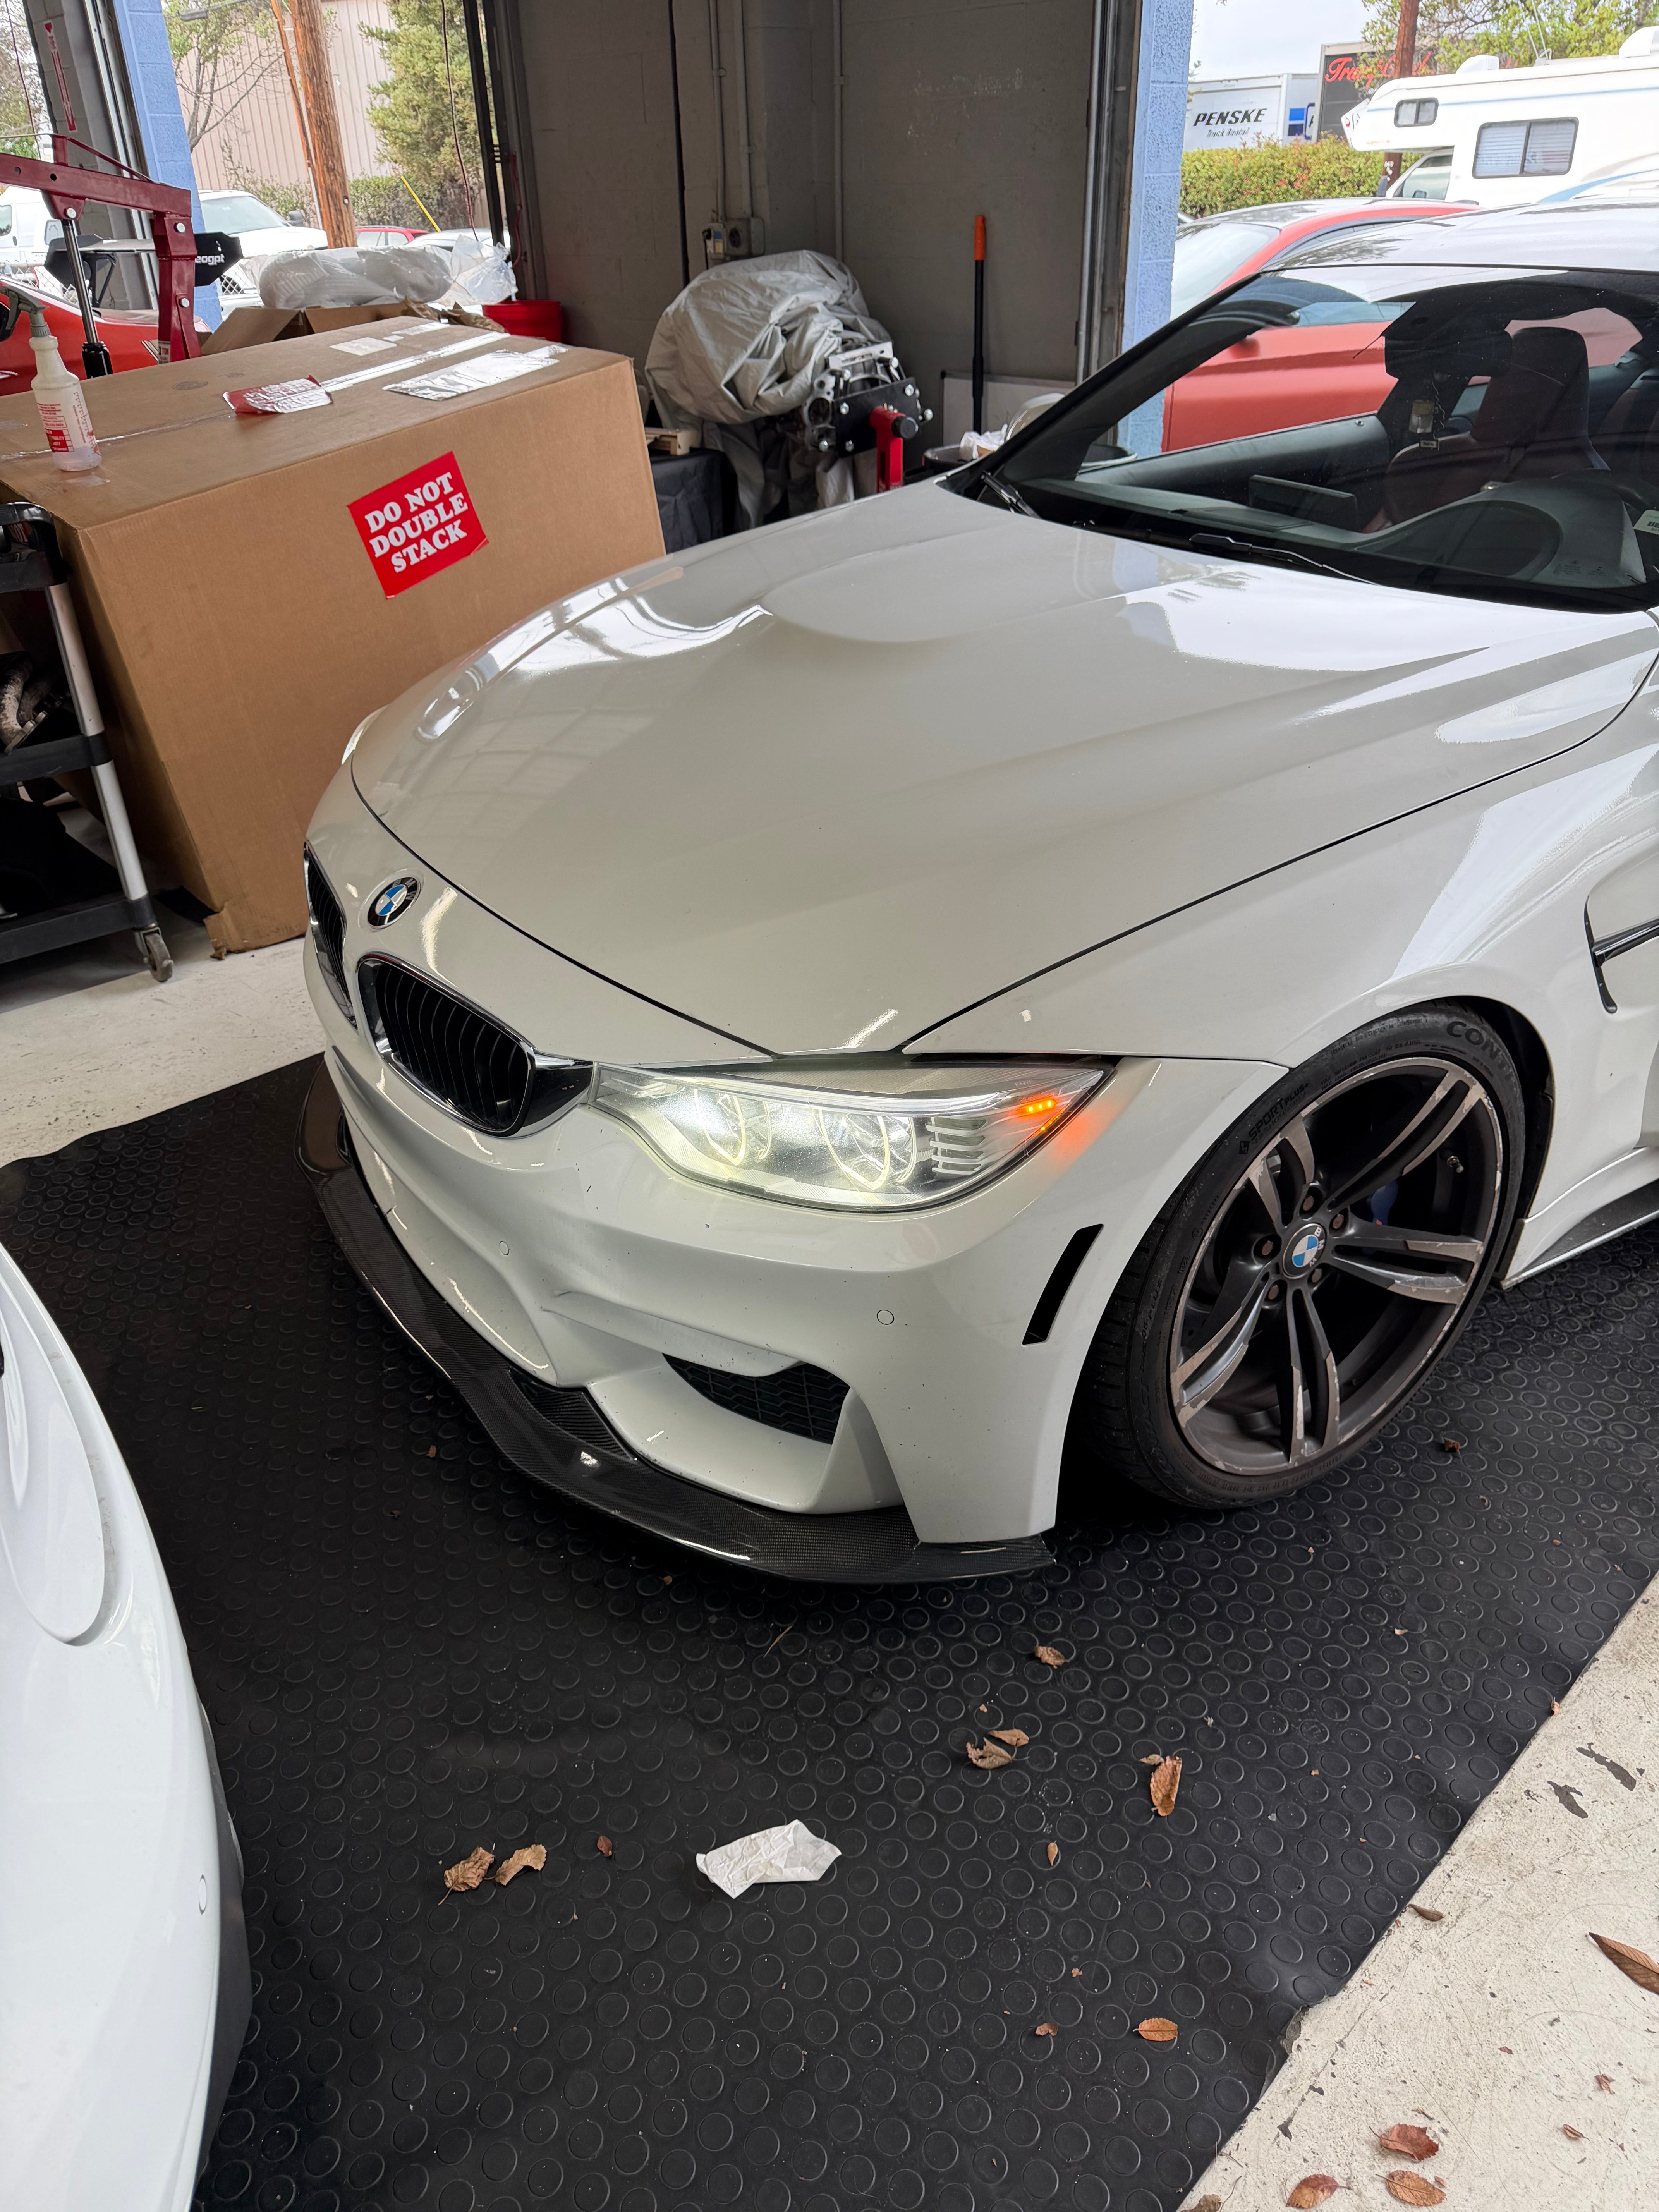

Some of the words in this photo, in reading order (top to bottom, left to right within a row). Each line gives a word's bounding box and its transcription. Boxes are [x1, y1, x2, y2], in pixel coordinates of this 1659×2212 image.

[1193, 108, 1267, 126] PENSKE
[1207, 129, 1224, 137] Truck
[1226, 127, 1250, 136] Rental
[365, 502, 402, 533] DO
[404, 472, 453, 512] NOT
[369, 492, 468, 558] DOUBLE
[391, 520, 467, 573] STACK
[392, 878, 417, 900] BMW
[1309, 1226, 1325, 1268] BMW
